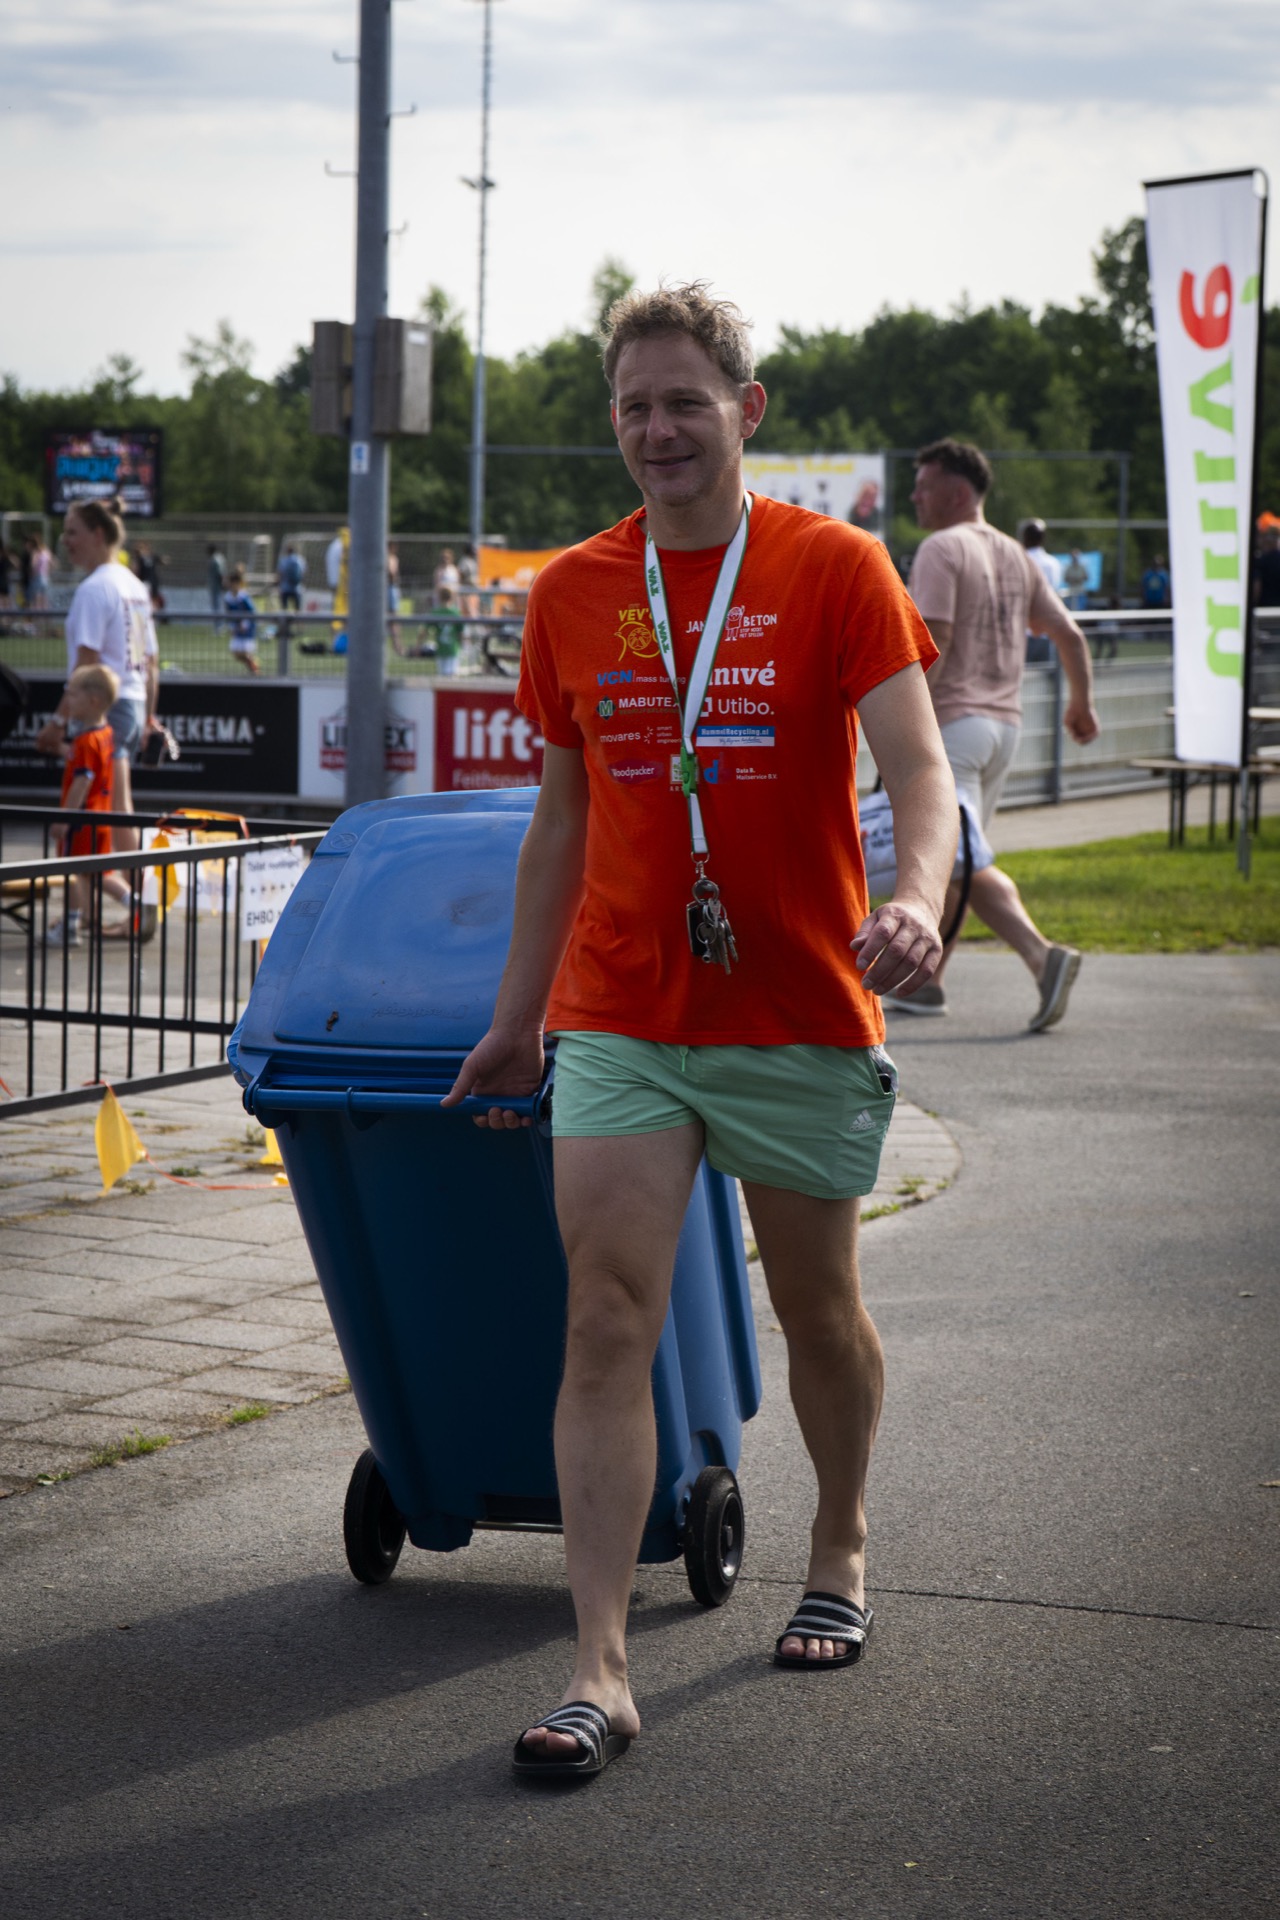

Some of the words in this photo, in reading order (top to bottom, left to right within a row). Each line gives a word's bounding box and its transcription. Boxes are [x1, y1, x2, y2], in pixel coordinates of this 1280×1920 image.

[618, 608, 652, 621] VEV'
[685, 620, 706, 633] JAN
[743, 613, 777, 627] BETON
[597, 669, 633, 686] VCN
[659, 675, 687, 684] turng
[708, 660, 776, 686] nivé
[717, 696, 775, 716] Utibo.
[156, 714, 254, 744] IEKEMA
[599, 731, 641, 743] movares
[246, 909, 274, 927] EHBO
[849, 1121, 876, 1132] adidas
